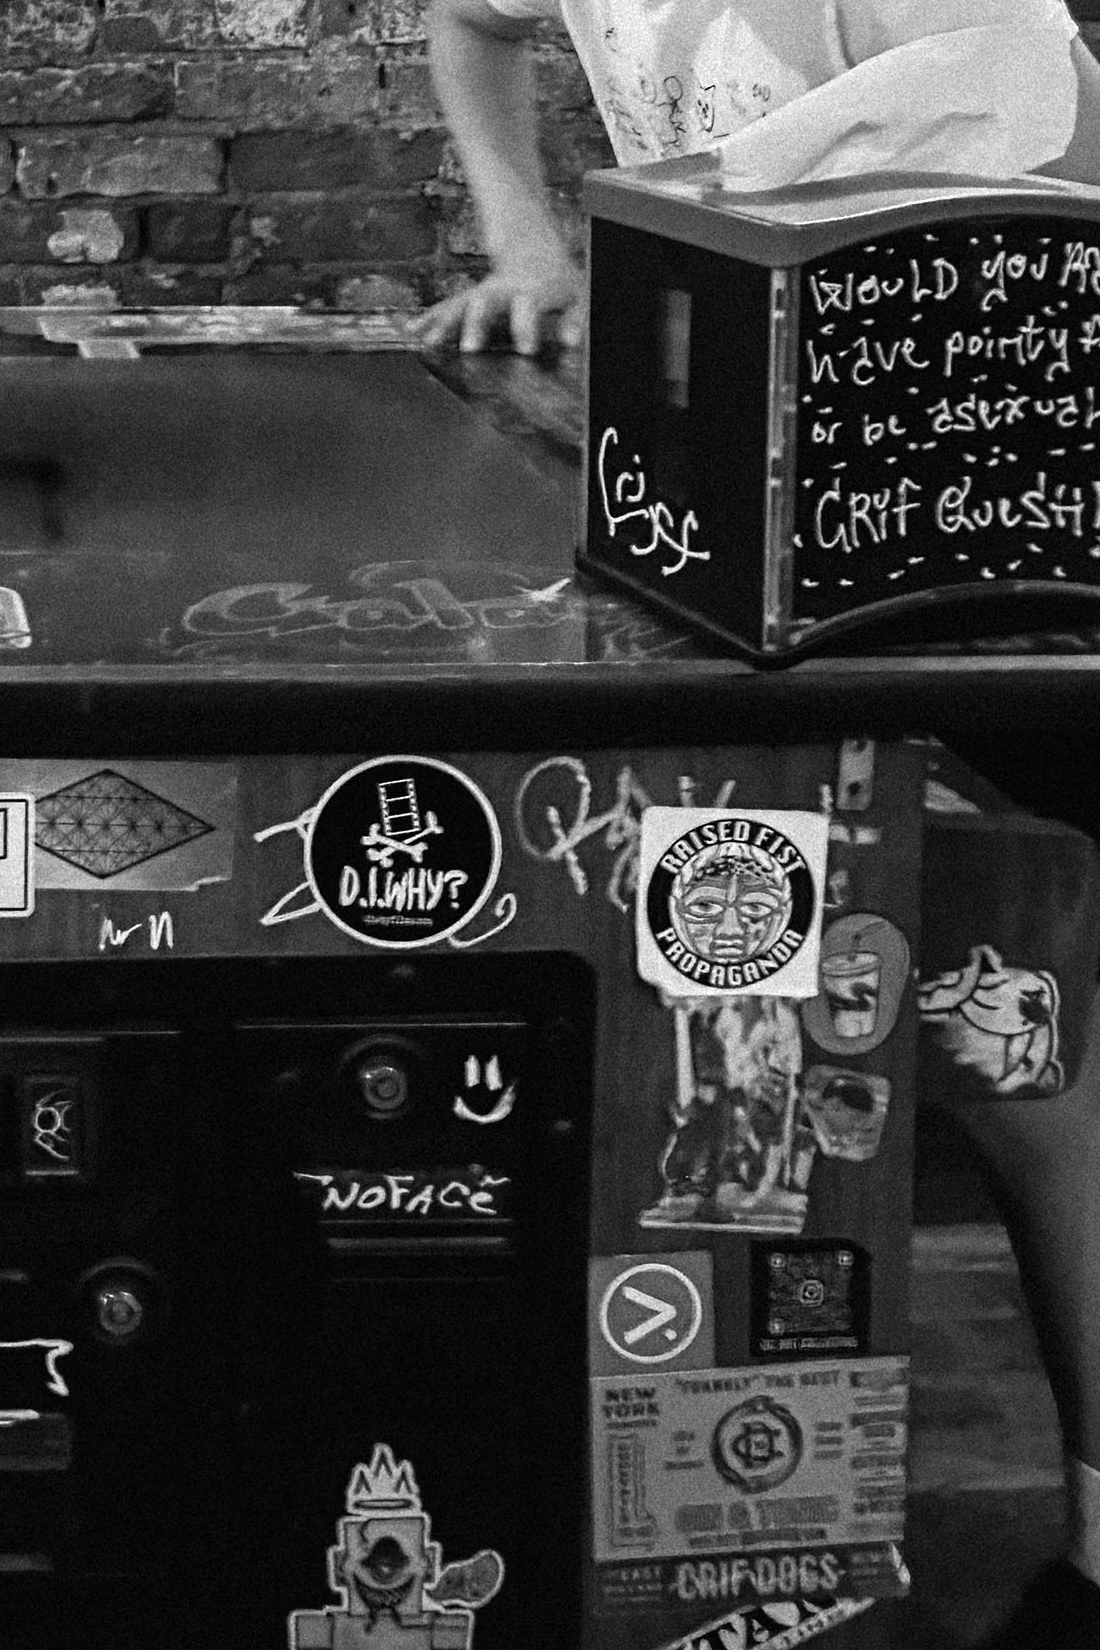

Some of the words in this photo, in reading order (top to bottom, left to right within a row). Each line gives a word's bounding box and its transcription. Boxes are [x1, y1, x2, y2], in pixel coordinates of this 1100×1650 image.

[811, 420, 843, 445] or
[863, 414, 907, 446] be
[660, 820, 751, 874] RAISED
[755, 827, 807, 873] FIST
[656, 927, 804, 986] PROPAGANDA
